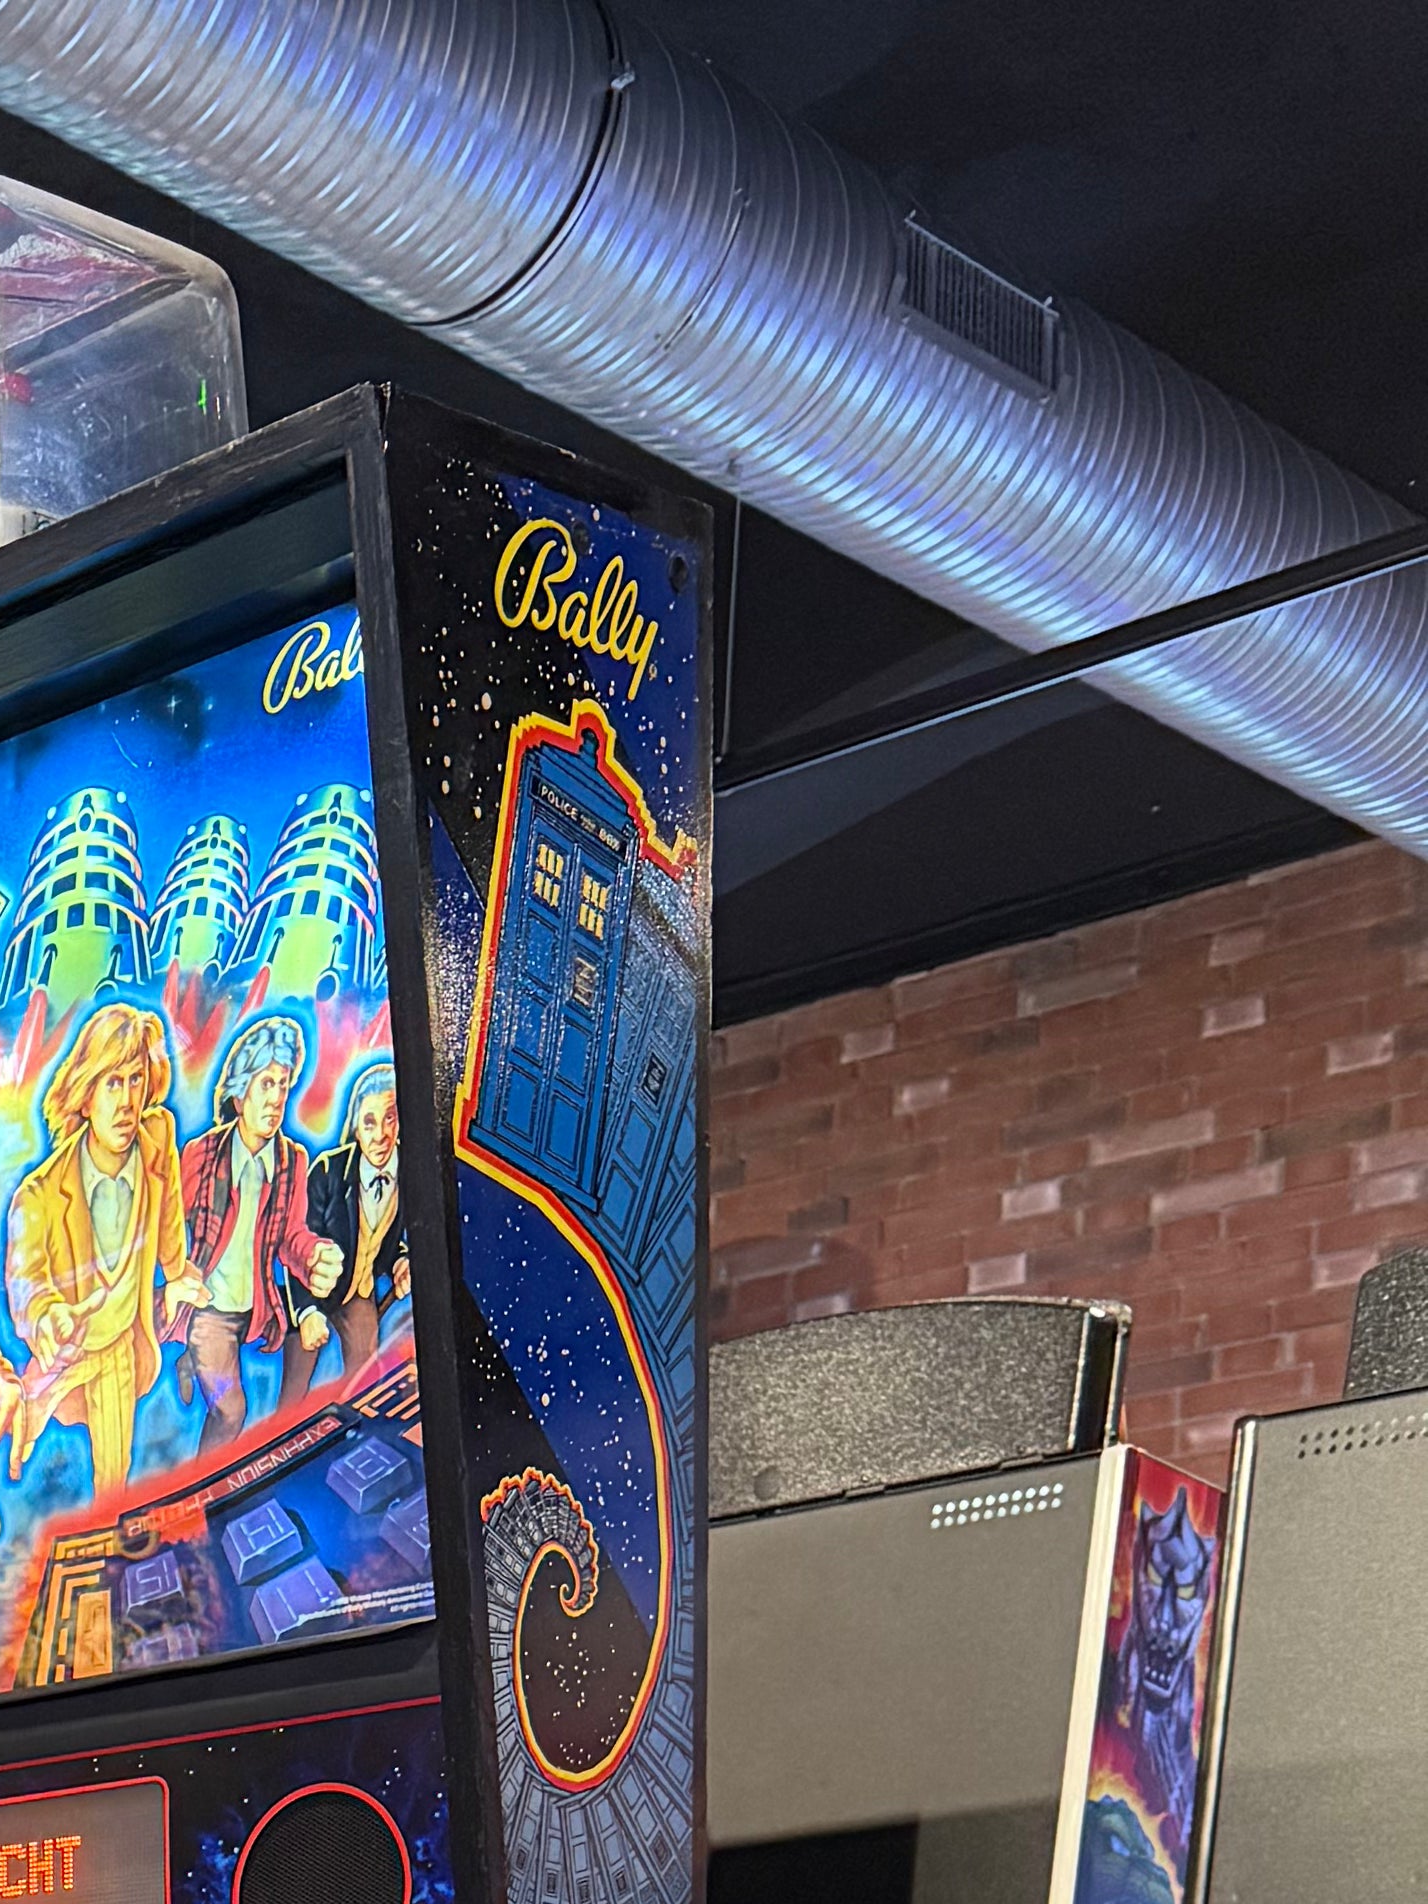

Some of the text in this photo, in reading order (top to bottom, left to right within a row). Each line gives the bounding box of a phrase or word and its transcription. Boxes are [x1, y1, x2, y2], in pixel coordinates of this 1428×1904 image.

[494, 518, 658, 700] Bally
[262, 615, 364, 714] Bal
[540, 785, 578, 821] POLICE
